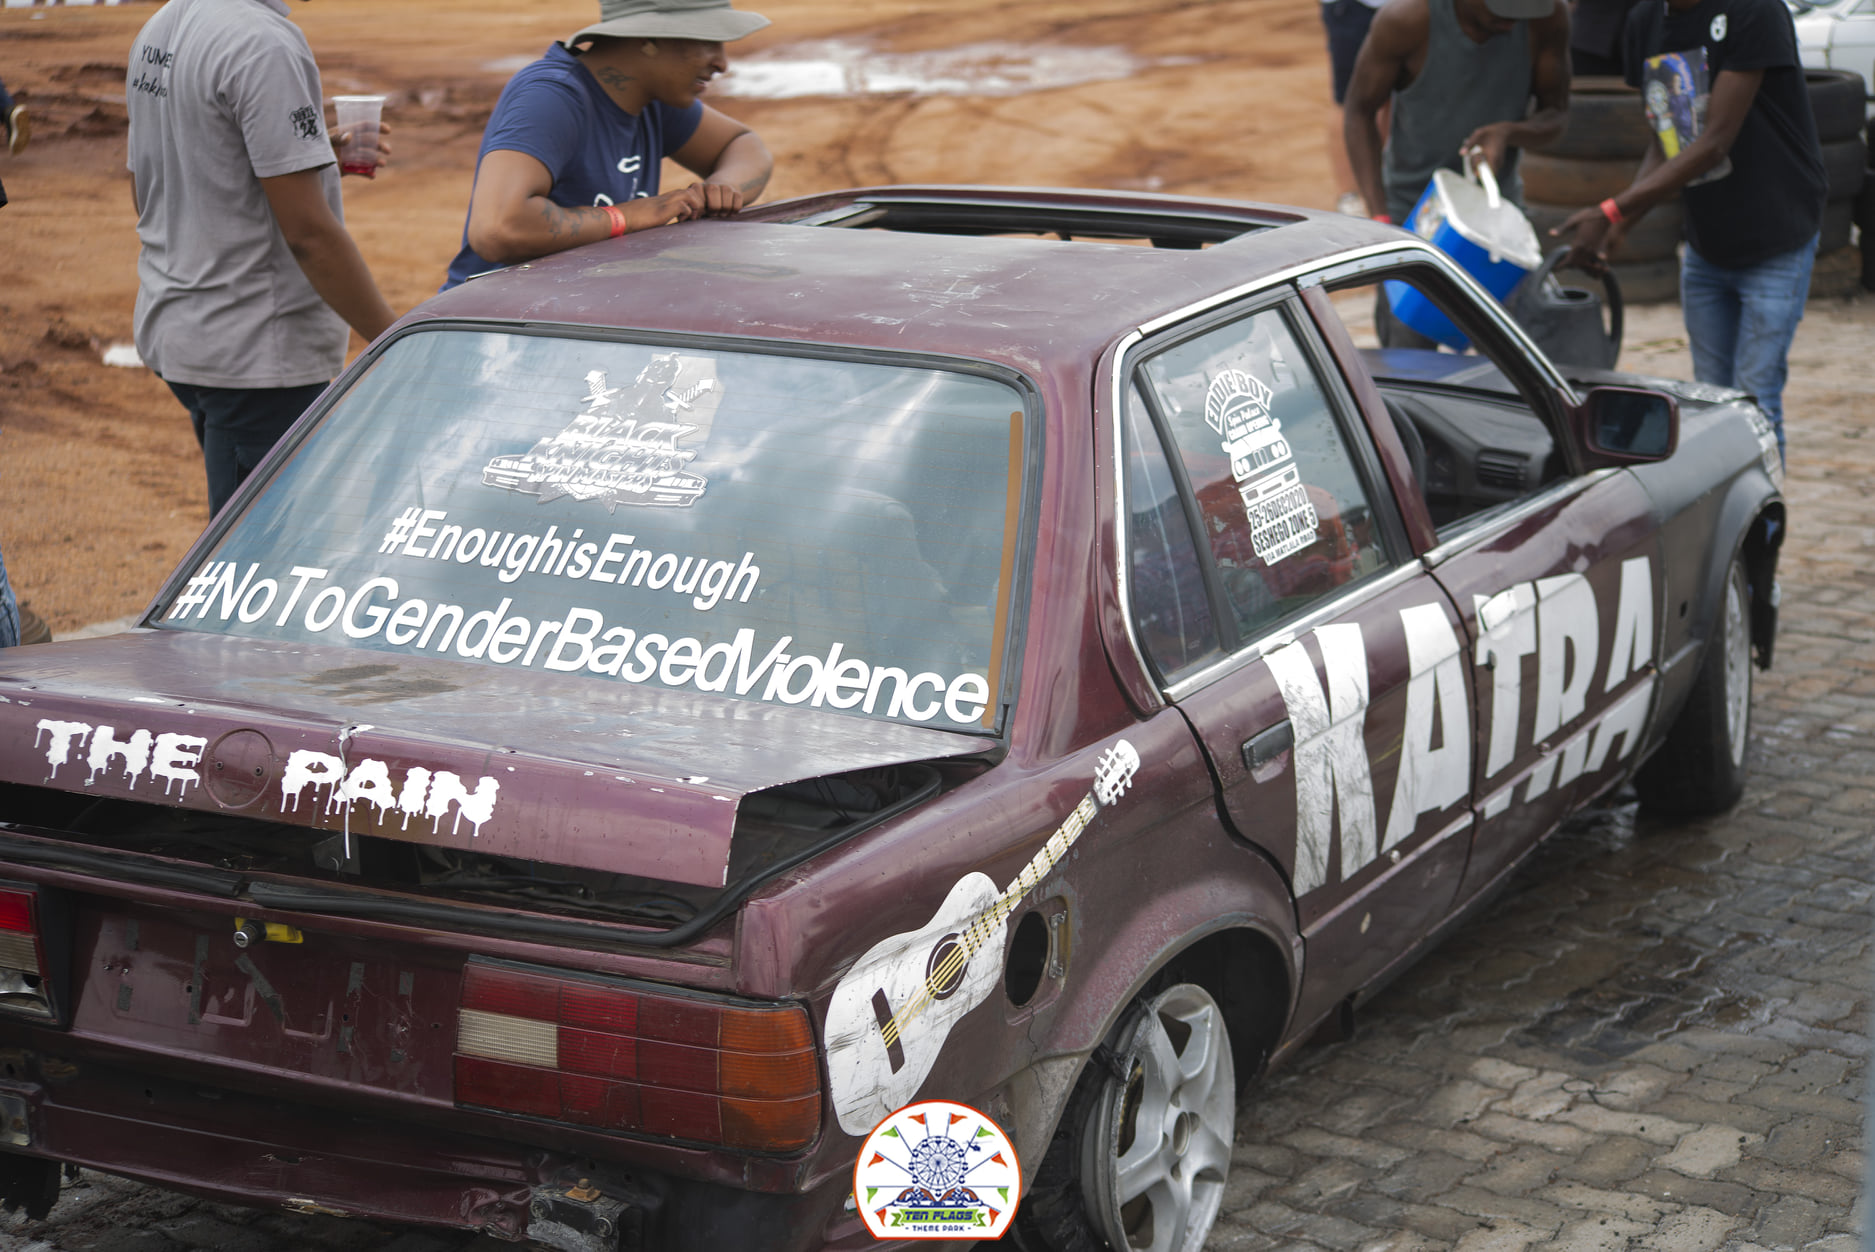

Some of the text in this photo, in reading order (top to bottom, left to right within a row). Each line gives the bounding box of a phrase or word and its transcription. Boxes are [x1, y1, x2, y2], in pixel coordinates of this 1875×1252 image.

[1206, 373, 1237, 431] EDDIE
[1233, 372, 1271, 407] BOY
[520, 436, 697, 477] KNIGHTS
[554, 414, 698, 450] BLACK
[378, 506, 761, 611] #EnoughisEnough
[1252, 506, 1317, 554] SESHEGO ZONE 5
[168, 559, 991, 724] #NoToGenderBasedViolence
[34, 718, 501, 837] THE PAIN
